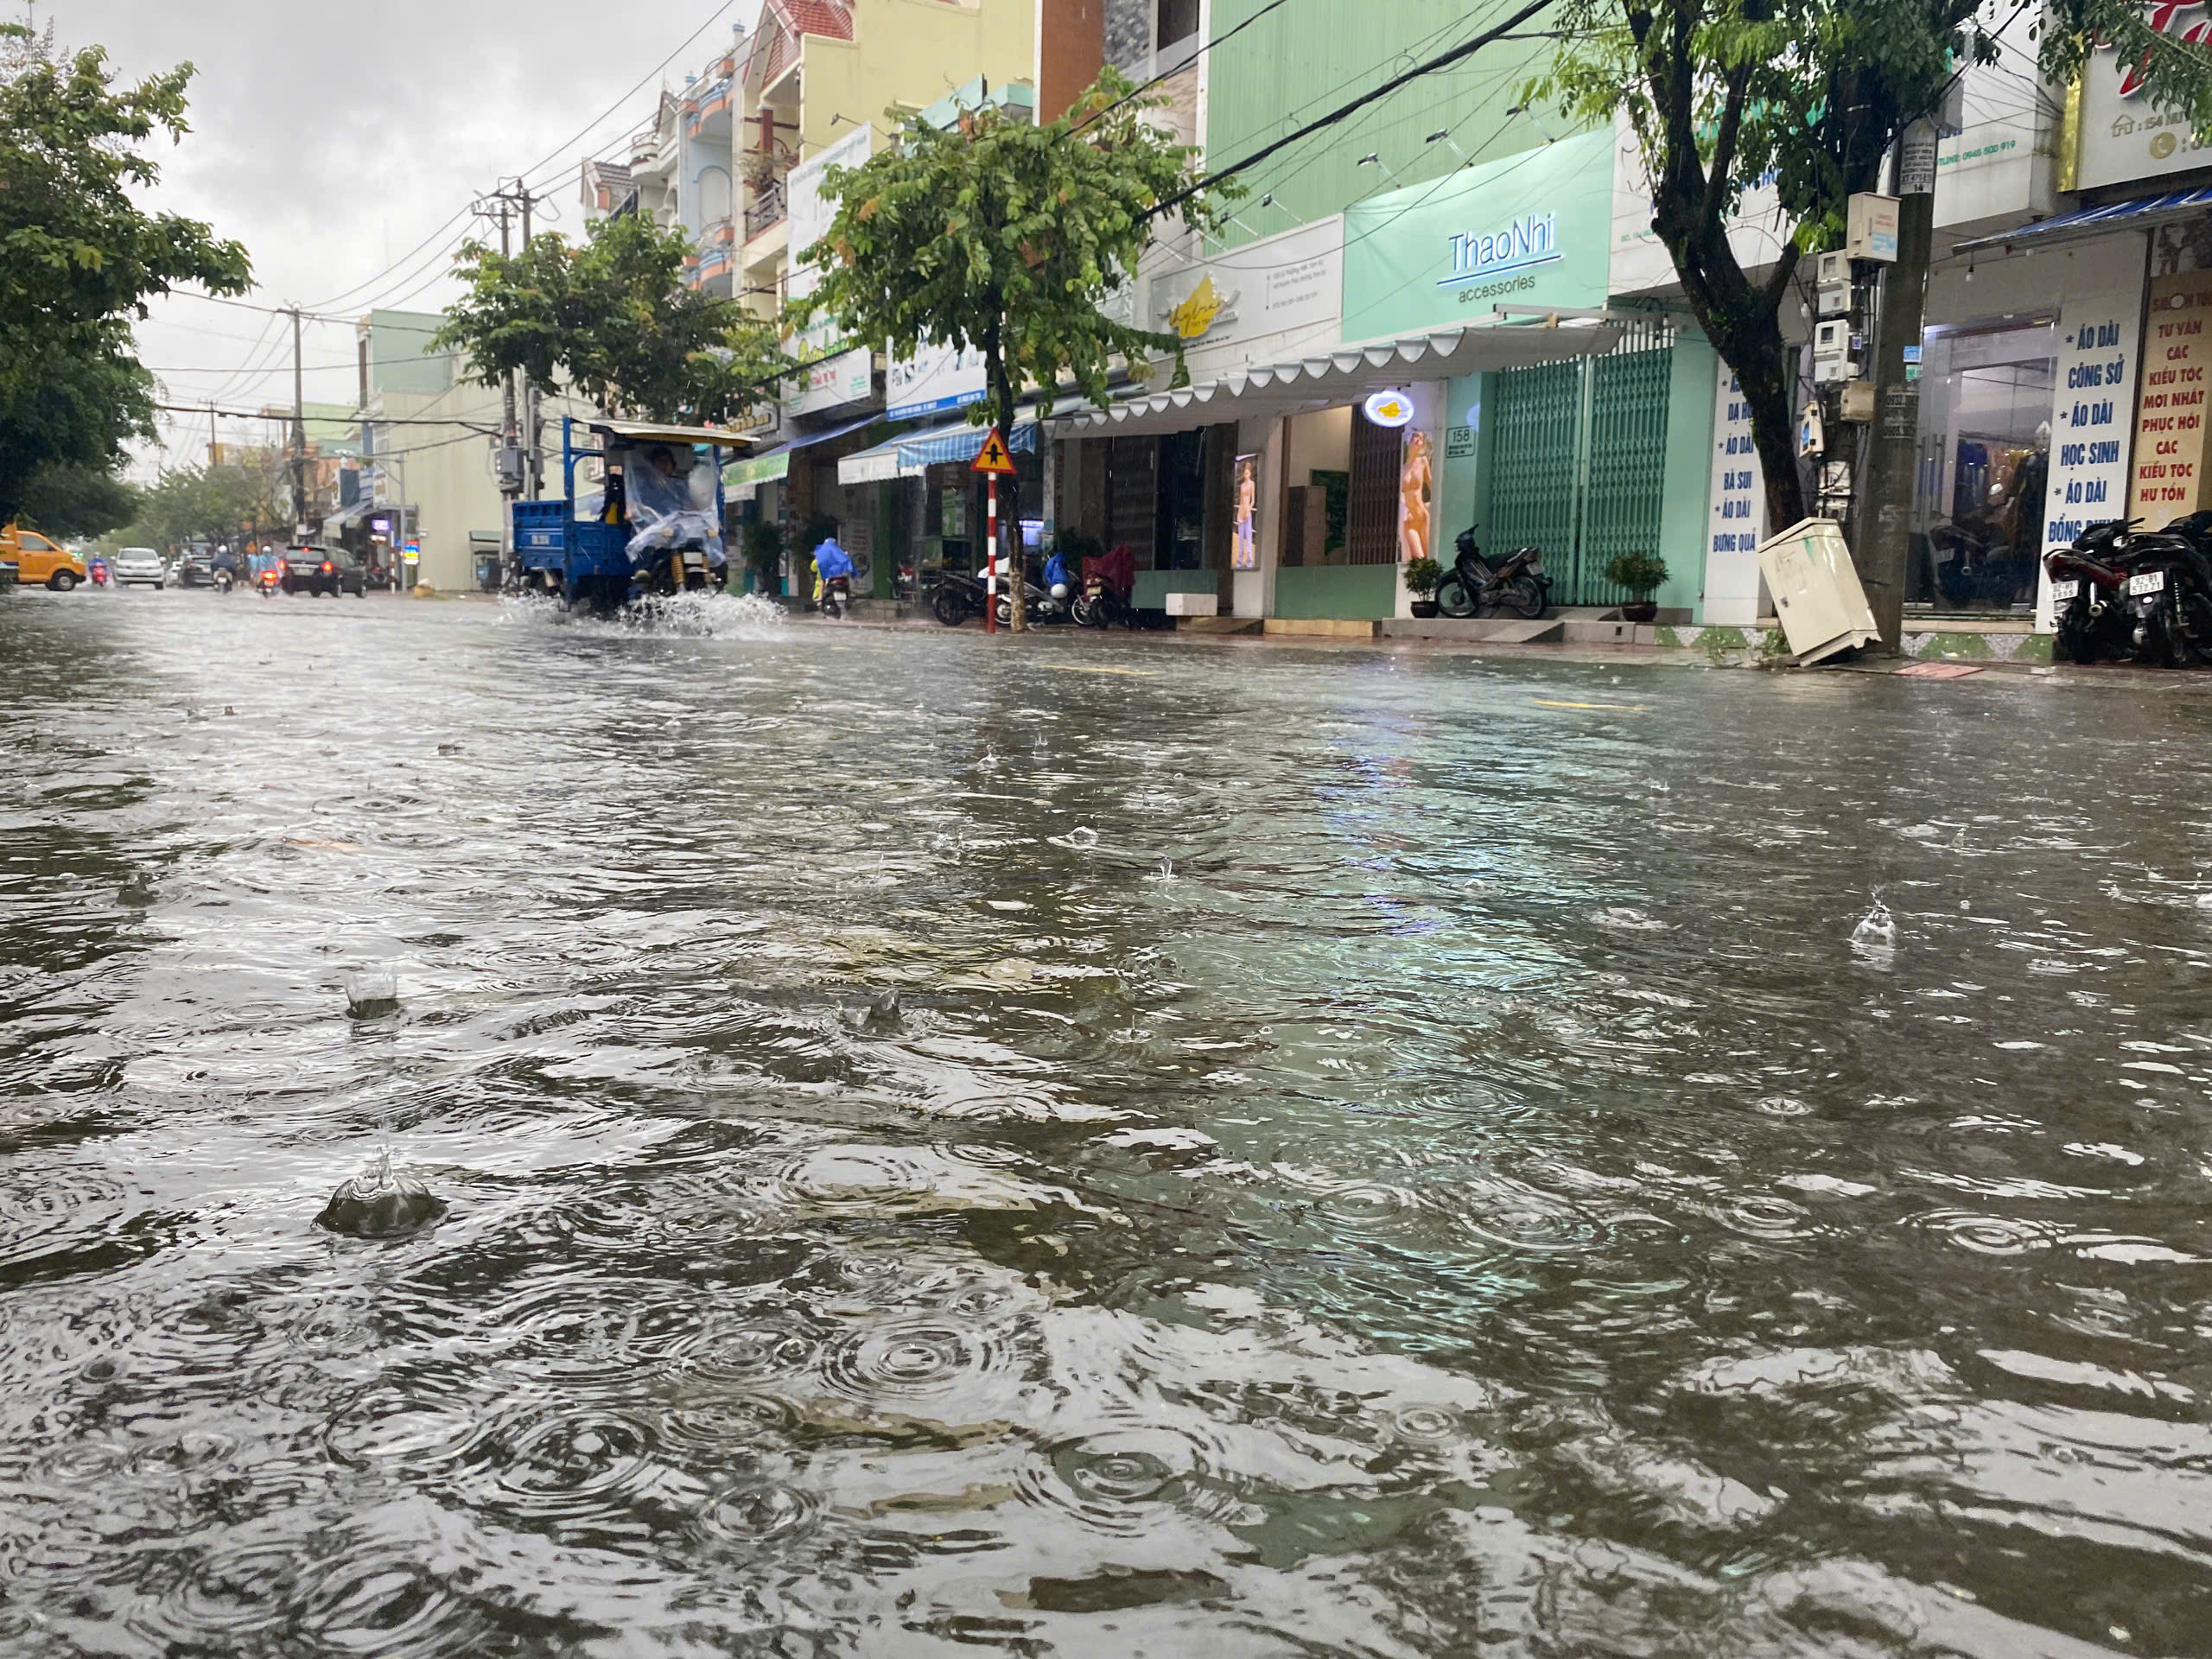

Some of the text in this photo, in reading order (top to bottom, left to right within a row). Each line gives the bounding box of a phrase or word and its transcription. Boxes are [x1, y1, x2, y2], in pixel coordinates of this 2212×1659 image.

[1448, 213, 1555, 270] ThaoNhi
[1459, 276, 1535, 302] accessories
[2076, 320, 2120, 351] ÁO DÀI
[2068, 353, 2125, 389] CÔNG SỞ
[2070, 398, 2113, 428] ÁO DÀI
[1452, 429, 1471, 442] 158
[1726, 432, 1754, 455] ÁO DÀI
[2060, 441, 2120, 470] HỌC SINH
[1724, 468, 1752, 491] BÀ SUI
[2065, 477, 2107, 504] ÁO DÀI
[1722, 496, 1751, 519] ÁO DÀI
[1738, 527, 1756, 553] QUẢ
